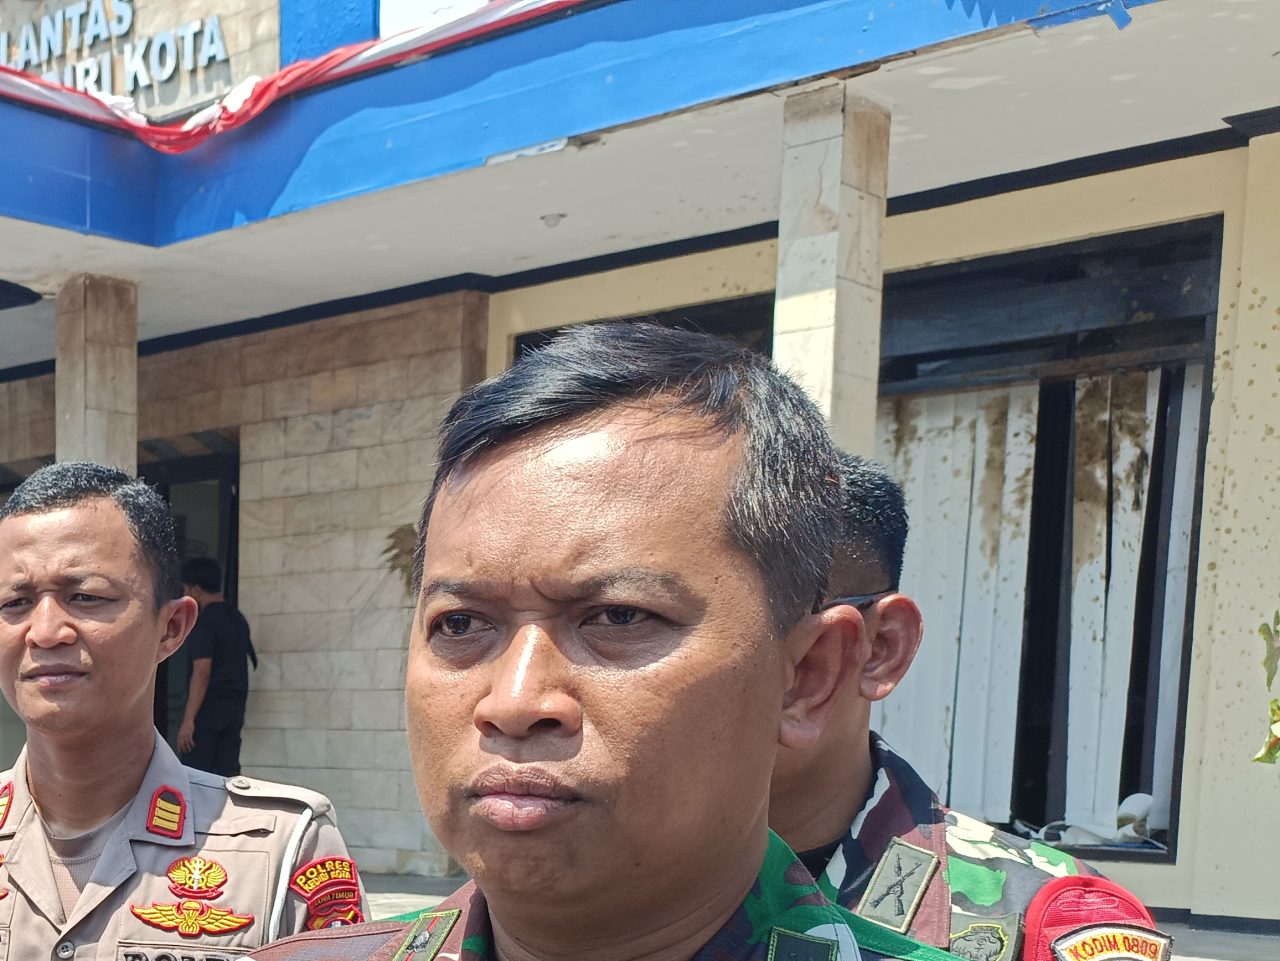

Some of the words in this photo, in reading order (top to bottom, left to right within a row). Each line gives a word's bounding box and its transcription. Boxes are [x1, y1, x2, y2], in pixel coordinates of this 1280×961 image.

[42, 52, 113, 94] IRI
[124, 15, 229, 92] KOTA
[296, 860, 351, 887] POLRES
[302, 872, 330, 892] KEDIRI
[330, 870, 351, 879] KOTA
[331, 891, 354, 900] TIMUR
[1070, 934, 1118, 961] KODIM
[1124, 936, 1158, 959] 0809
